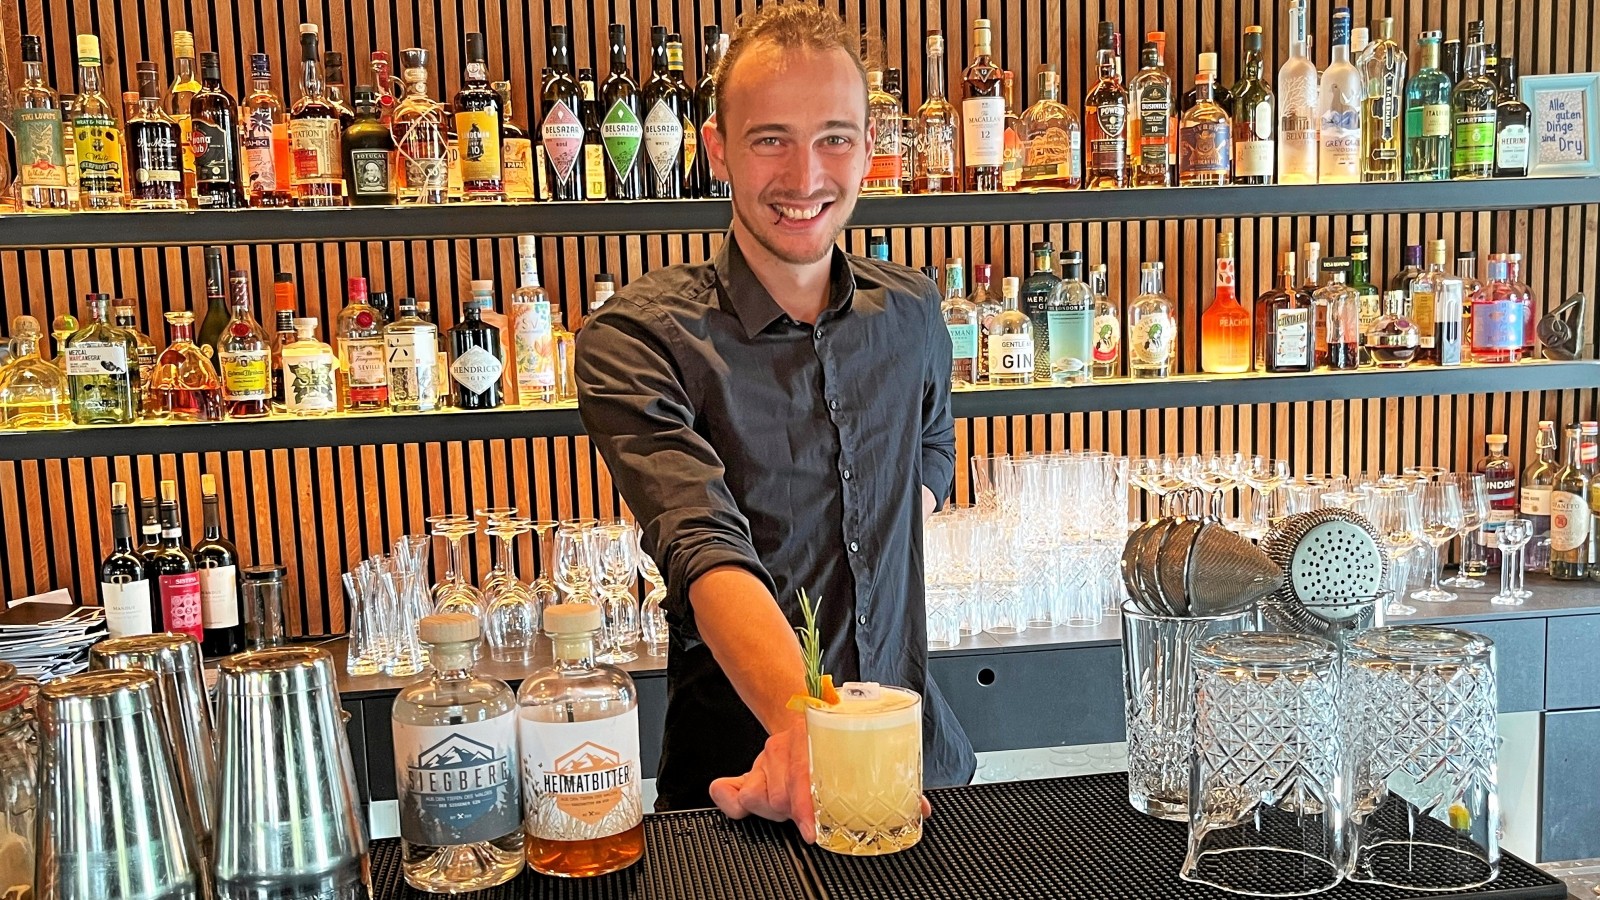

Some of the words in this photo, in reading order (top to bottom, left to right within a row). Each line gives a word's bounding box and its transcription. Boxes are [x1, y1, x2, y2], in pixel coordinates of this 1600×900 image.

[1549, 98, 1565, 110] Alle
[1556, 110, 1581, 122] guten
[546, 126, 579, 134] BELSAZAR
[605, 124, 638, 132] BELSAZAR
[1546, 121, 1573, 134] Dinge
[471, 146, 480, 154] 10
[1542, 133, 1556, 142] sind
[1559, 137, 1582, 155] Dry
[1002, 354, 1032, 368] GIN
[408, 761, 508, 792] SIEGBERG
[544, 765, 630, 793] HEIMATBITTER
